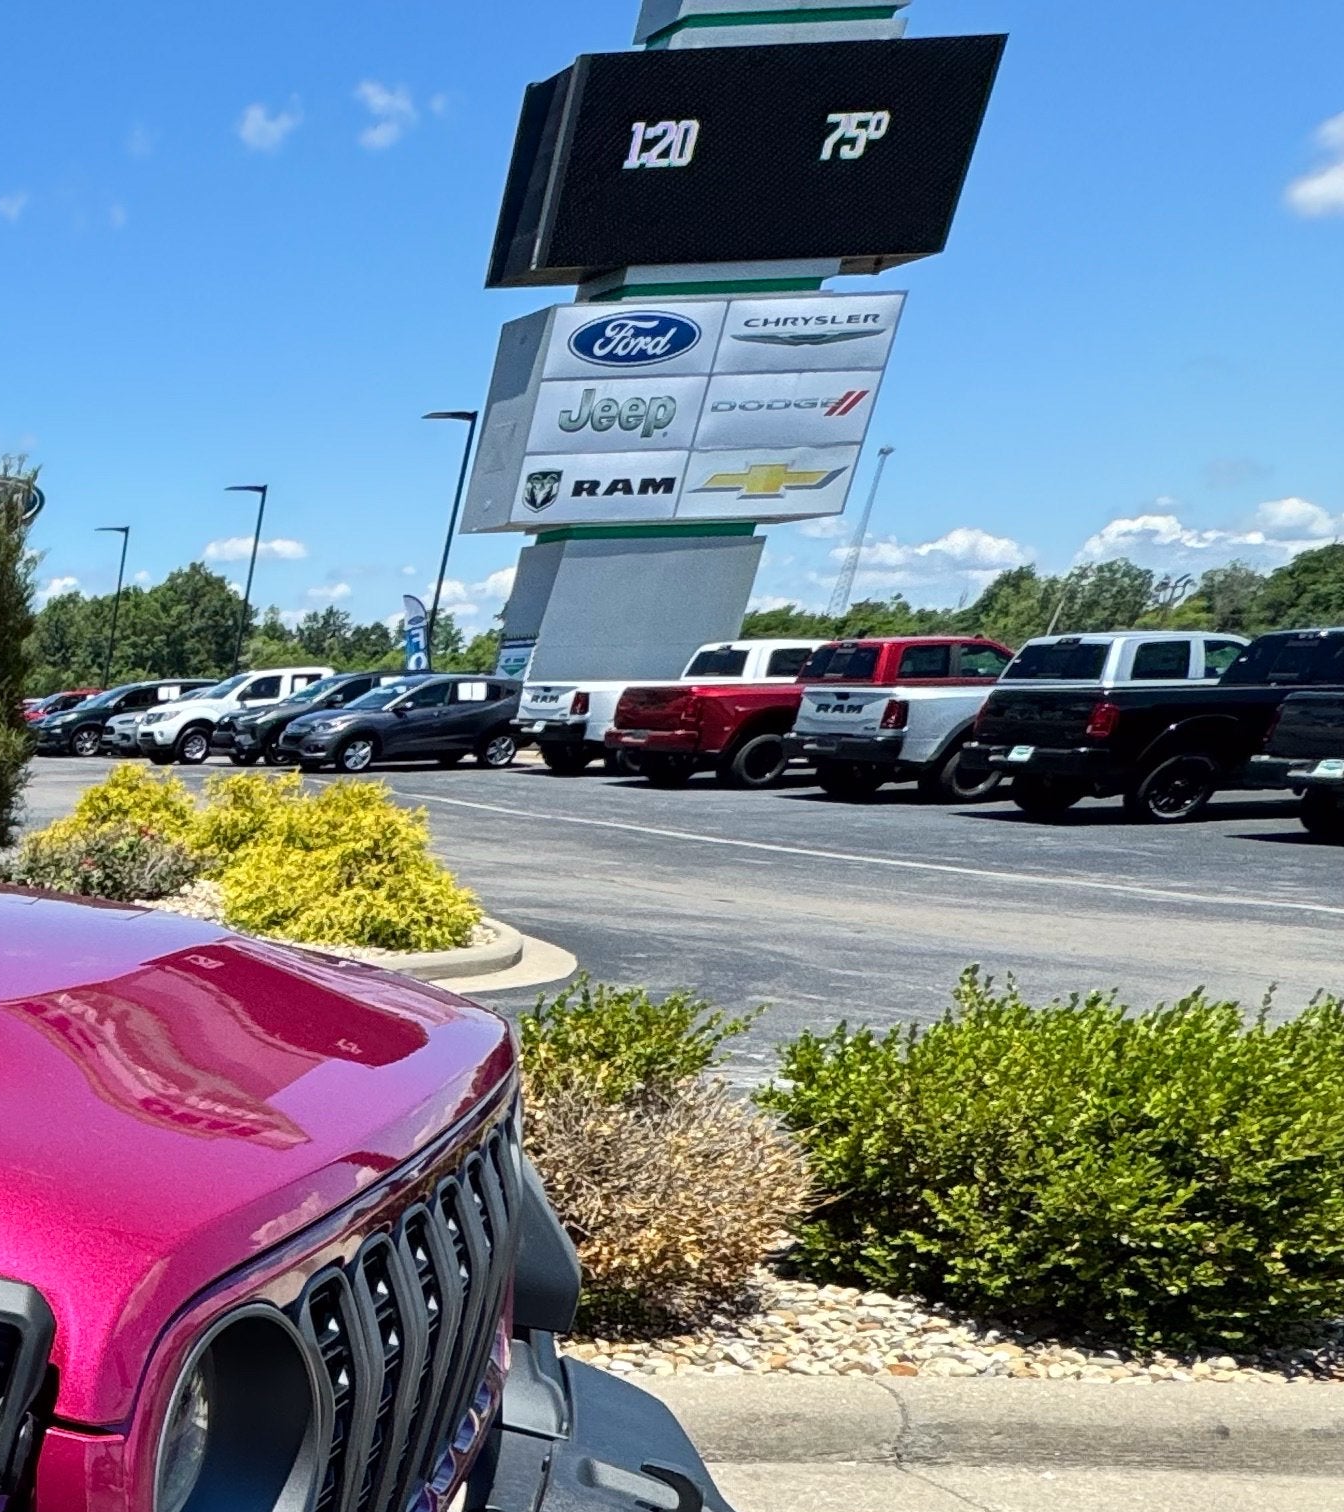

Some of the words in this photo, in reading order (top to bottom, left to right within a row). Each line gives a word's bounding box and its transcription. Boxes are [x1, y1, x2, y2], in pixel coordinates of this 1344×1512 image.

[743, 312, 881, 329] CHRYSLER
[592, 317, 678, 357] Ford
[558, 388, 677, 438] Jeep
[710, 397, 843, 414] DODGE
[571, 477, 677, 498] RAM
[530, 694, 560, 704] RAM
[815, 703, 863, 714] RAM
